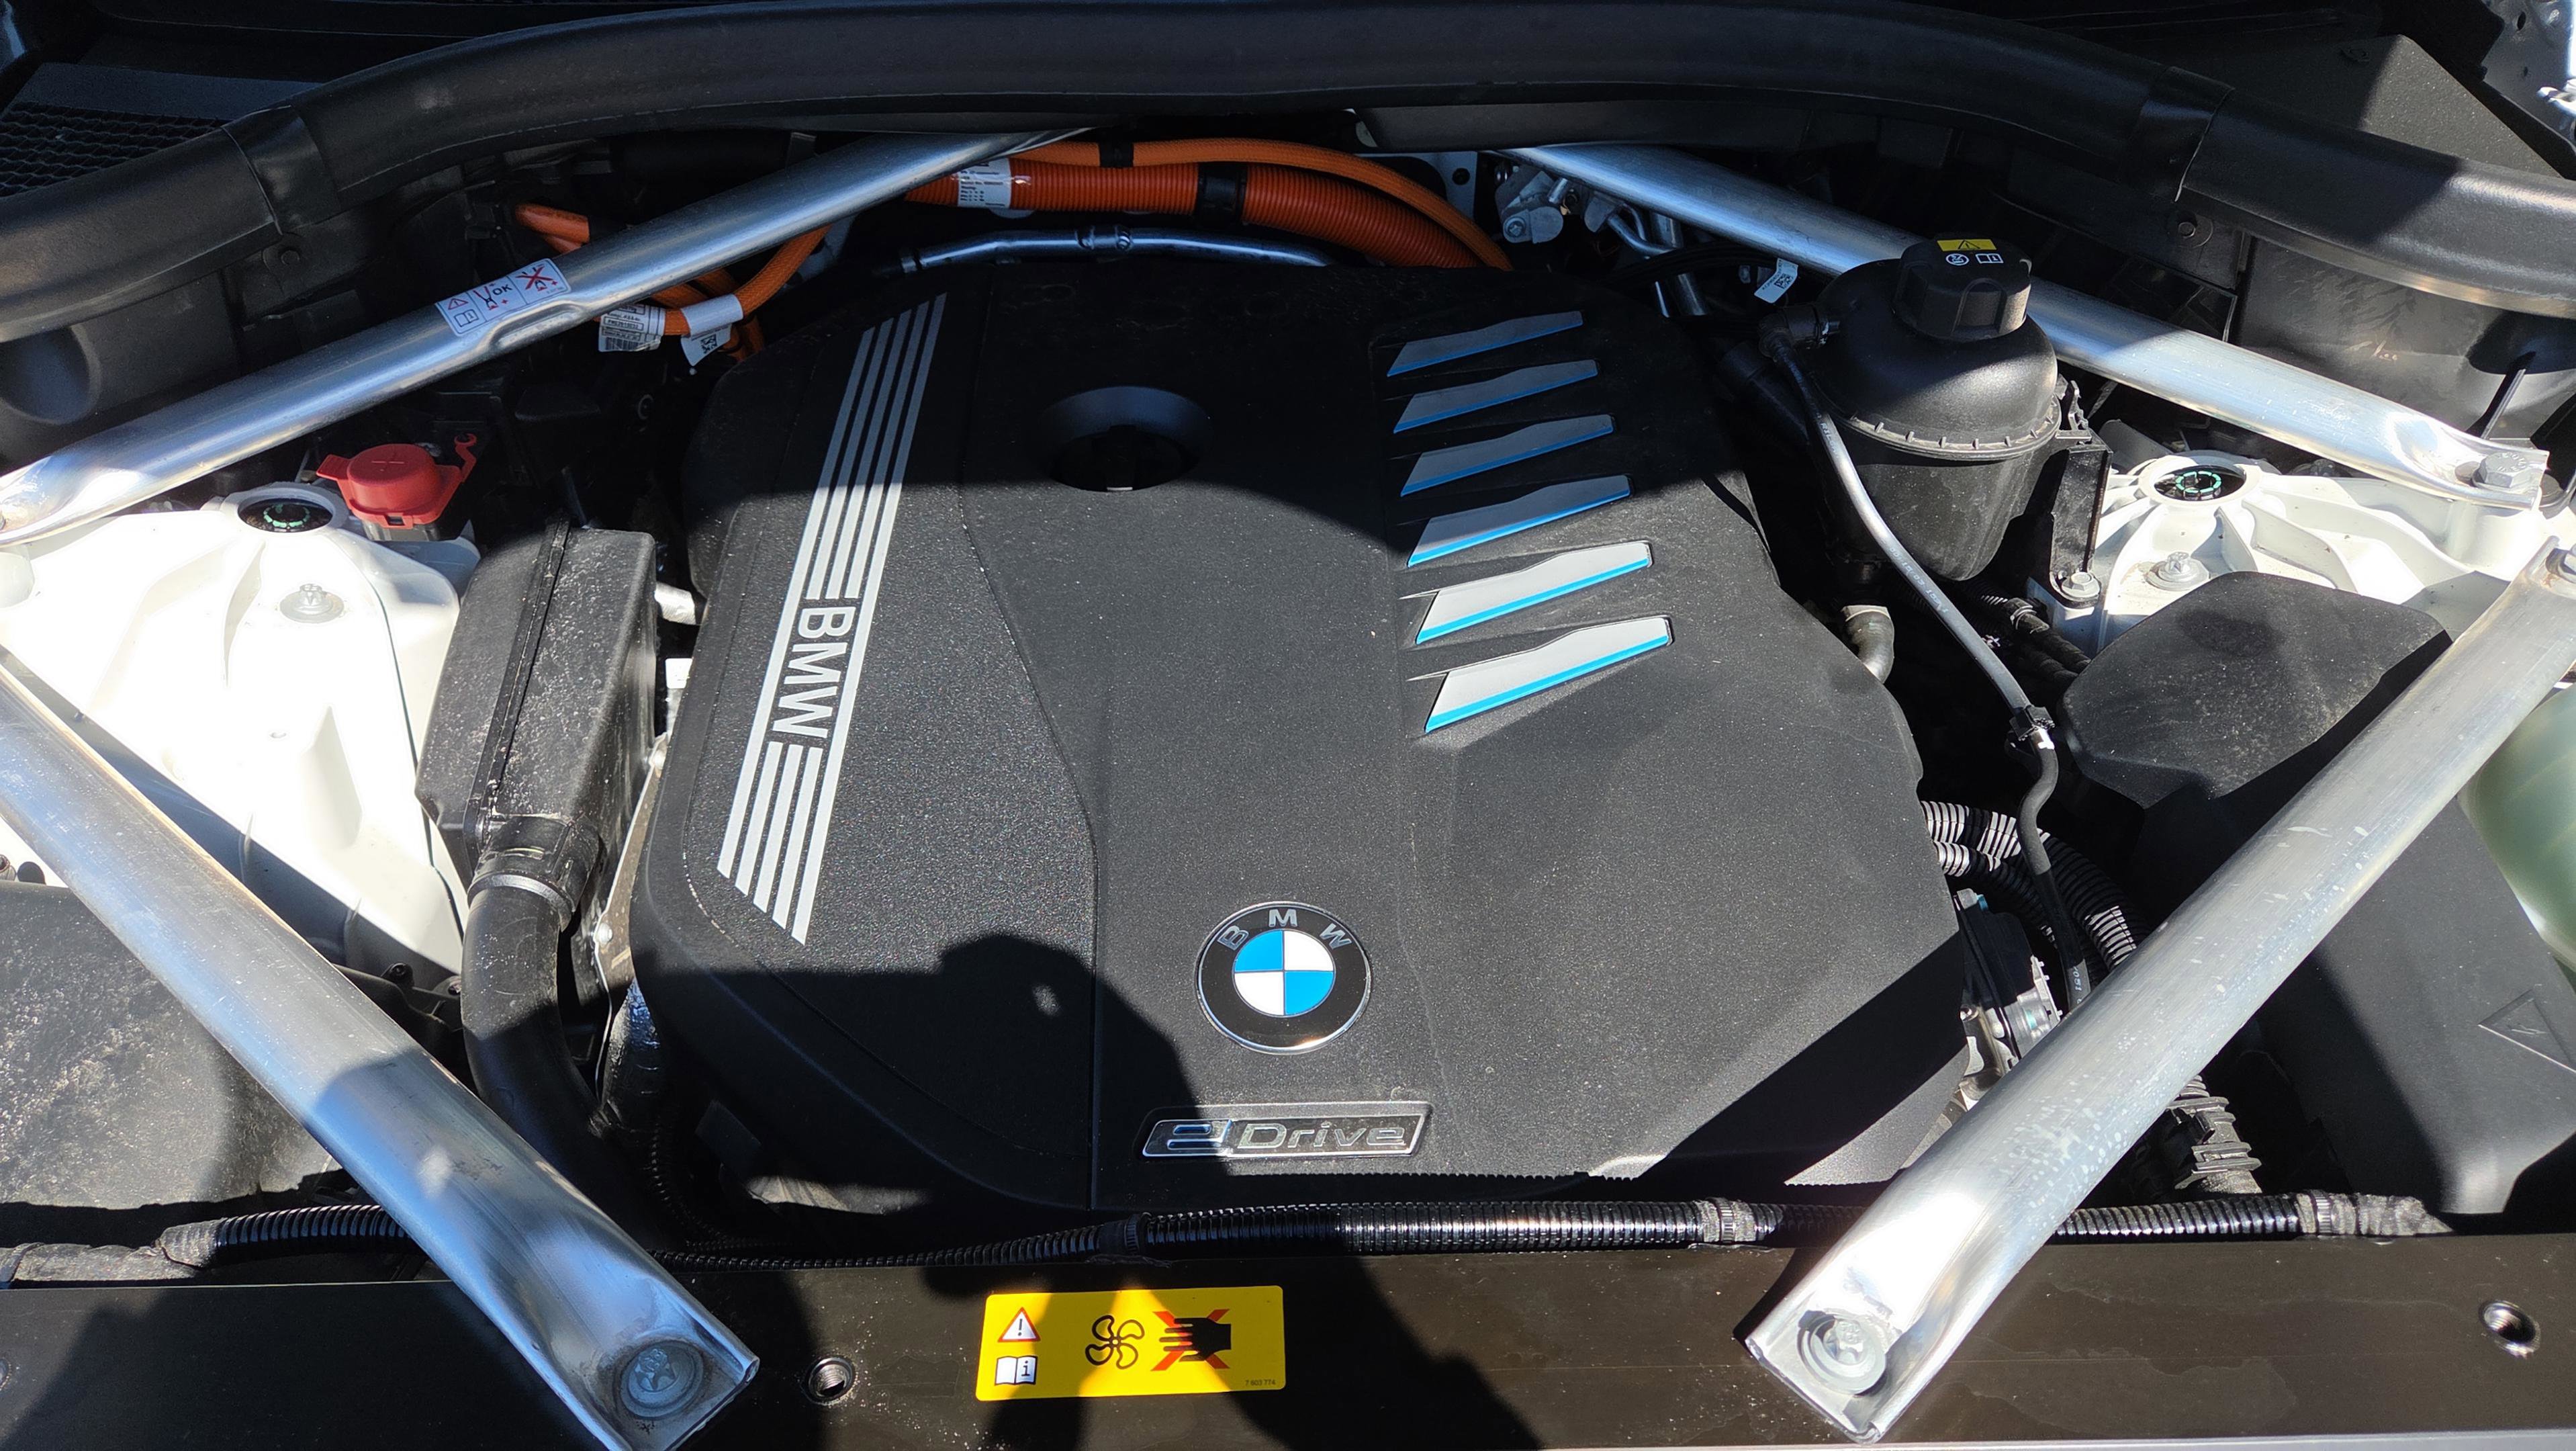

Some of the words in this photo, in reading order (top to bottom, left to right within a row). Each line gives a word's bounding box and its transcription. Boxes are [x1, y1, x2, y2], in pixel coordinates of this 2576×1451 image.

[492, 283, 513, 296] OK
[772, 606, 856, 739] BMW
[1217, 908, 1352, 951] BMW
